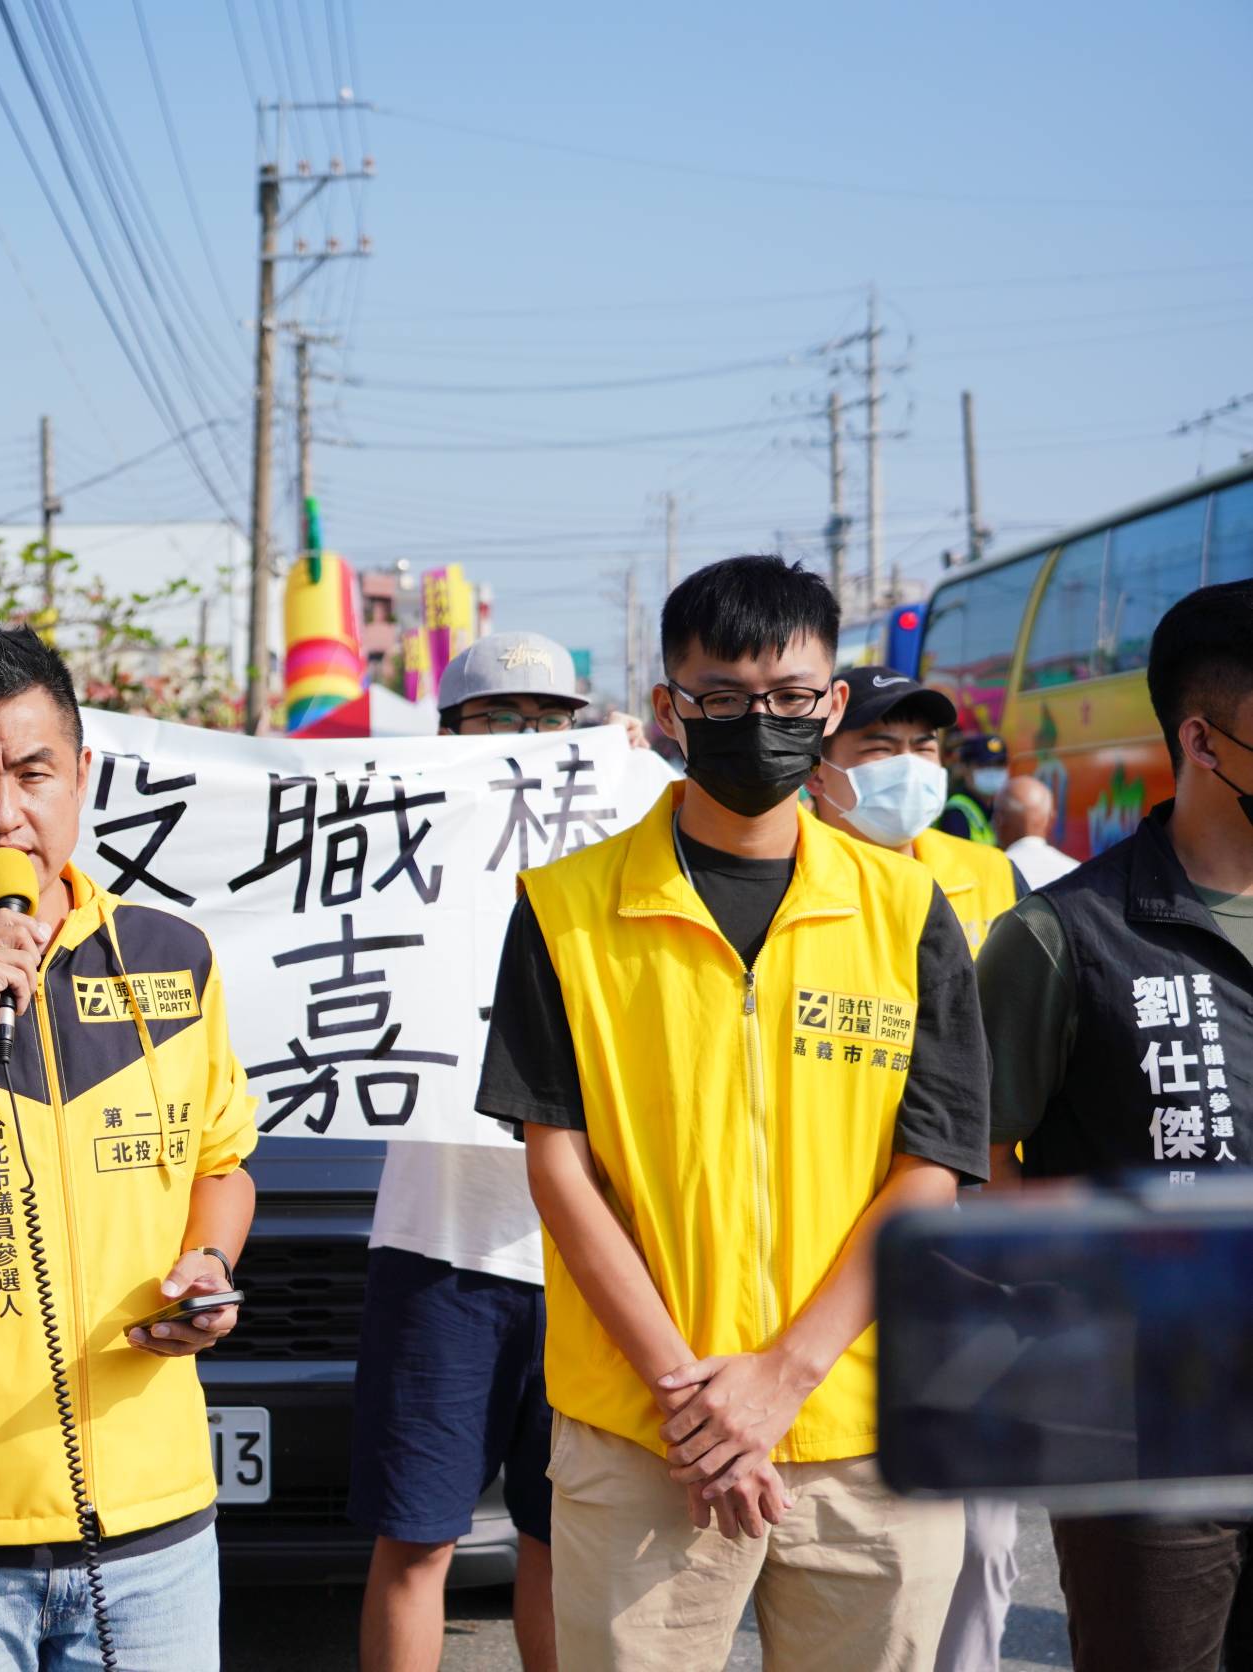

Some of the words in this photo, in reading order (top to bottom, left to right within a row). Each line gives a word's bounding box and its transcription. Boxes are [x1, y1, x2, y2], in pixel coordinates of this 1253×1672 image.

[154, 977, 176, 989] NEW
[157, 988, 192, 1001] POWER
[159, 1001, 191, 1013] PARTY
[838, 997, 873, 1016] 時代
[882, 1003, 903, 1016] NEW
[837, 1015, 872, 1035] 力量
[881, 1015, 912, 1031] POWER
[880, 1028, 908, 1041] PARTY
[792, 1036, 912, 1073] 嘉義市黨部
[1131, 974, 1207, 1160] 劉仕傑
